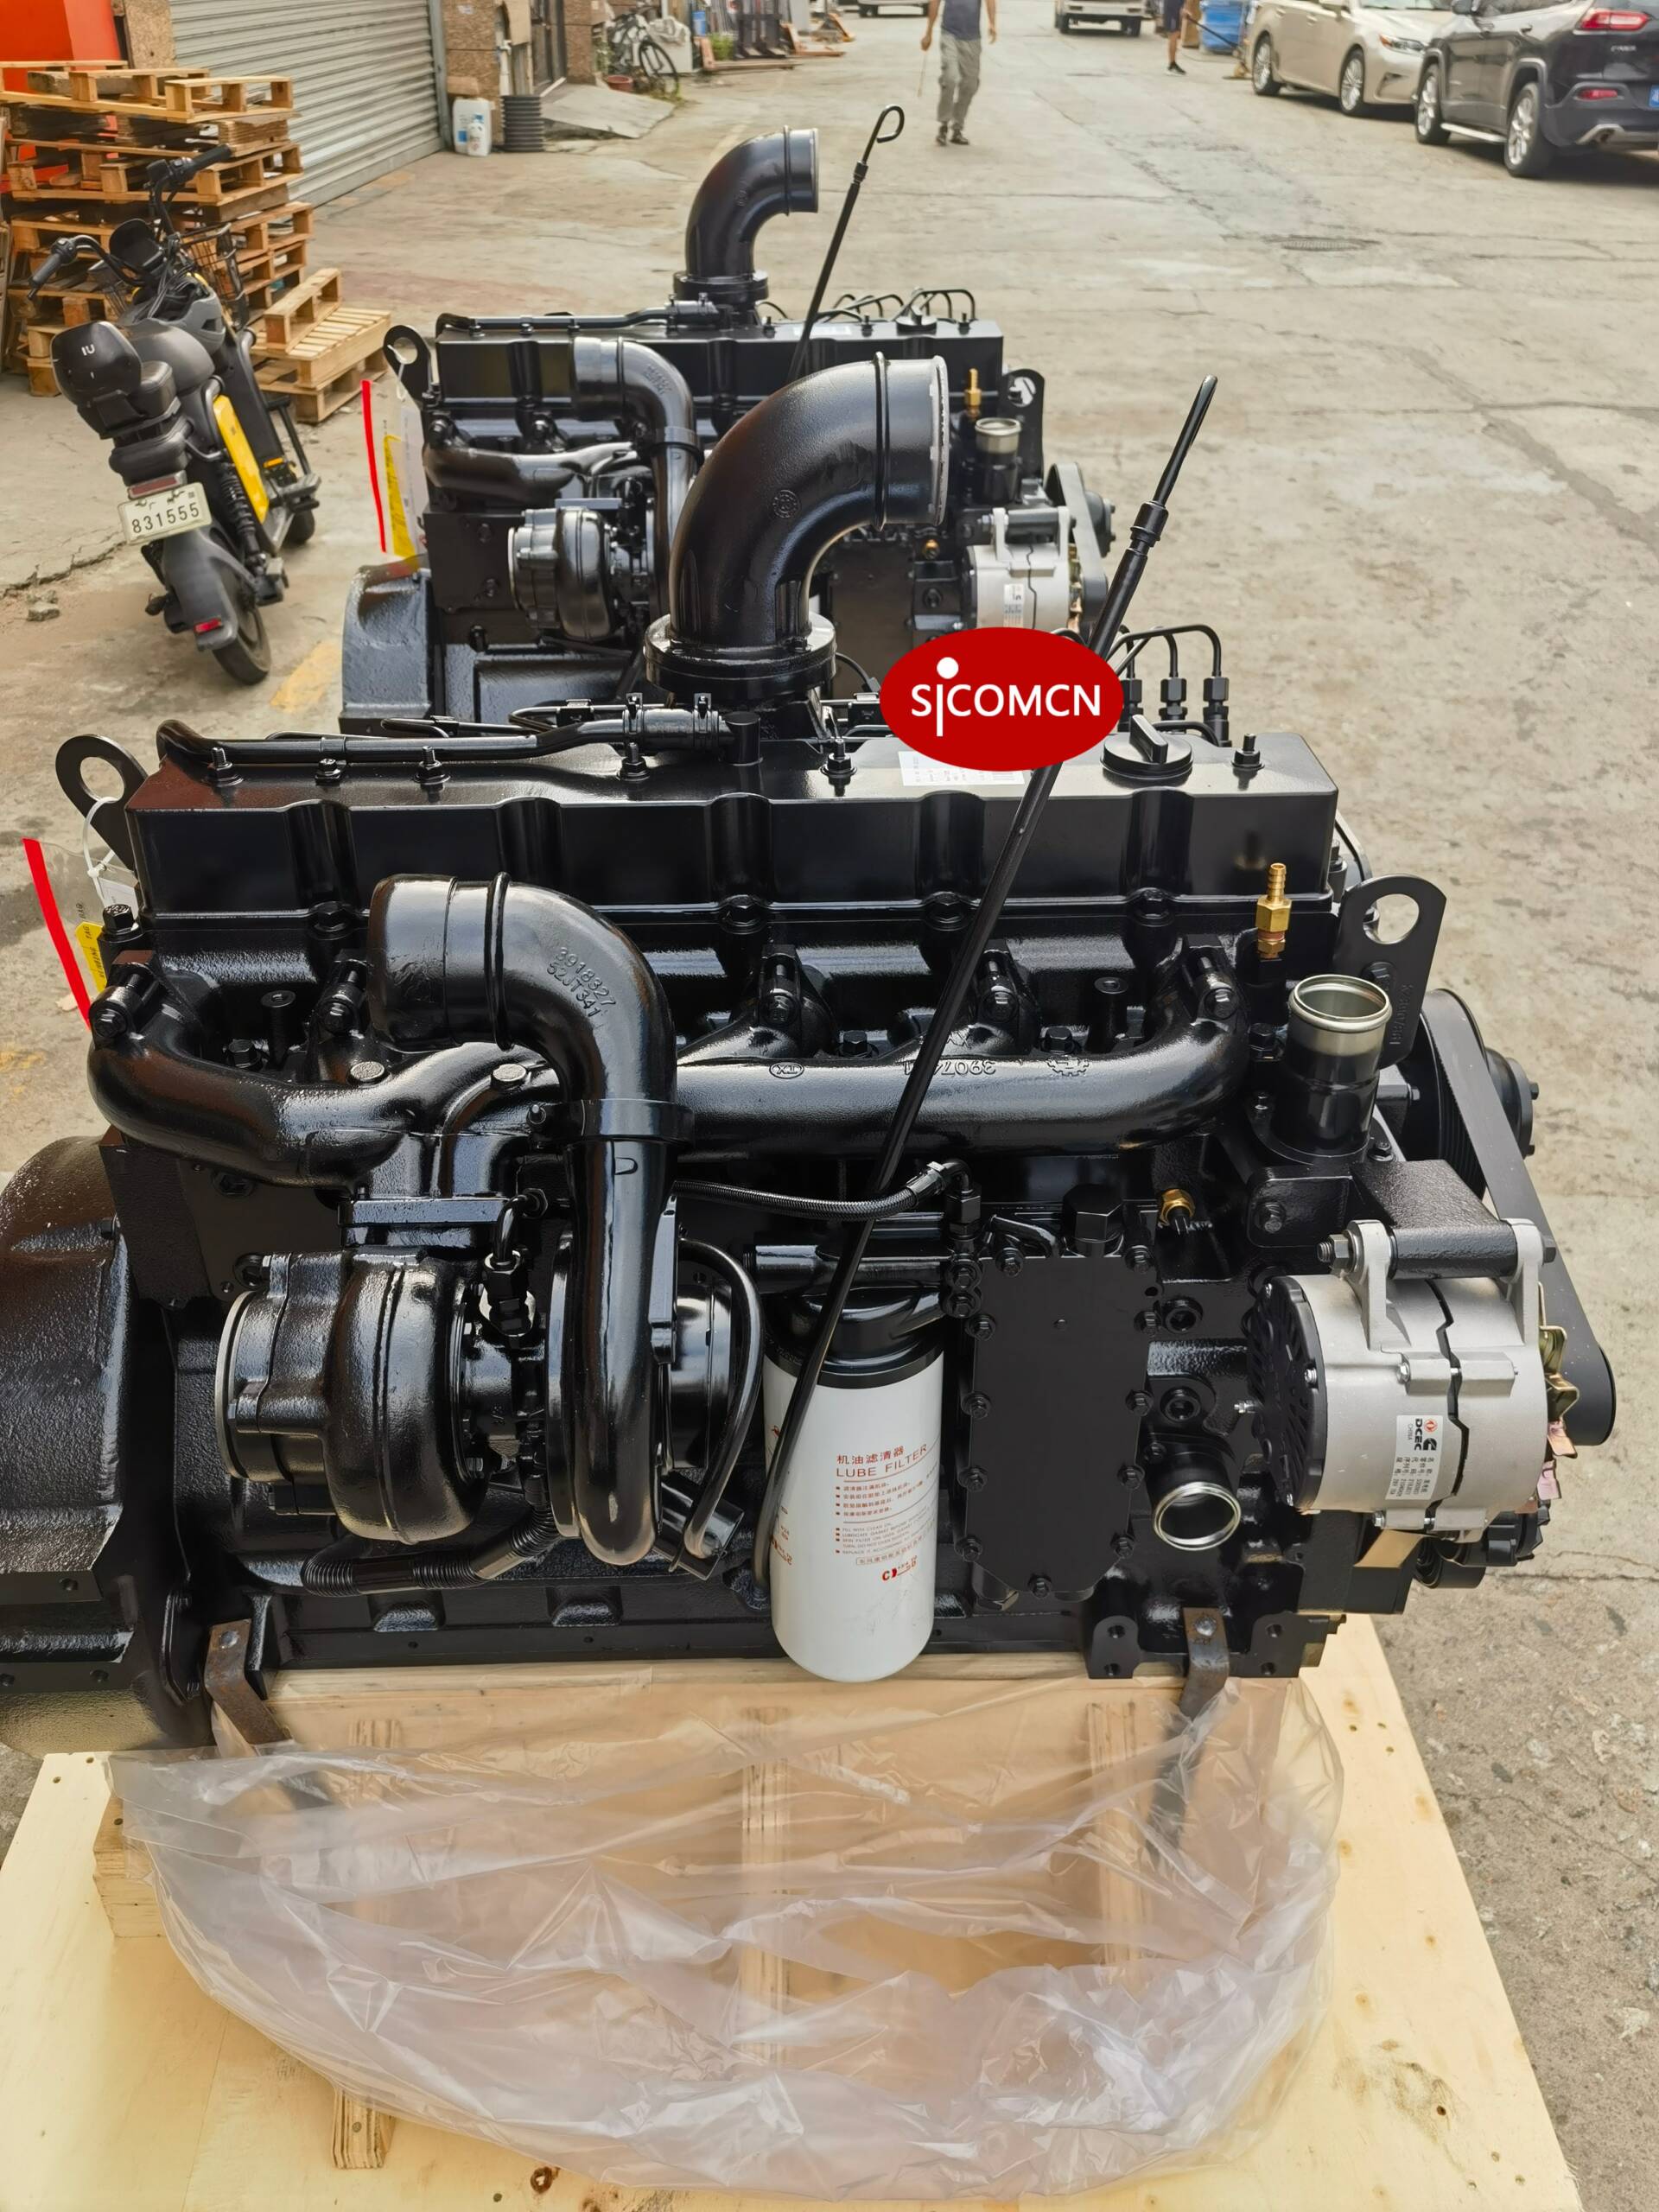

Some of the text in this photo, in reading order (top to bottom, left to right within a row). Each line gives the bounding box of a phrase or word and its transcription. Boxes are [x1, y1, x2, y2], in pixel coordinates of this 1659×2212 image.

[132, 502, 199, 533] 831555
[1414, 1419, 1423, 1451] DCEC
[836, 1446, 905, 1465] 机油滤清器
[836, 1444, 927, 1478] LUBE FILTER
